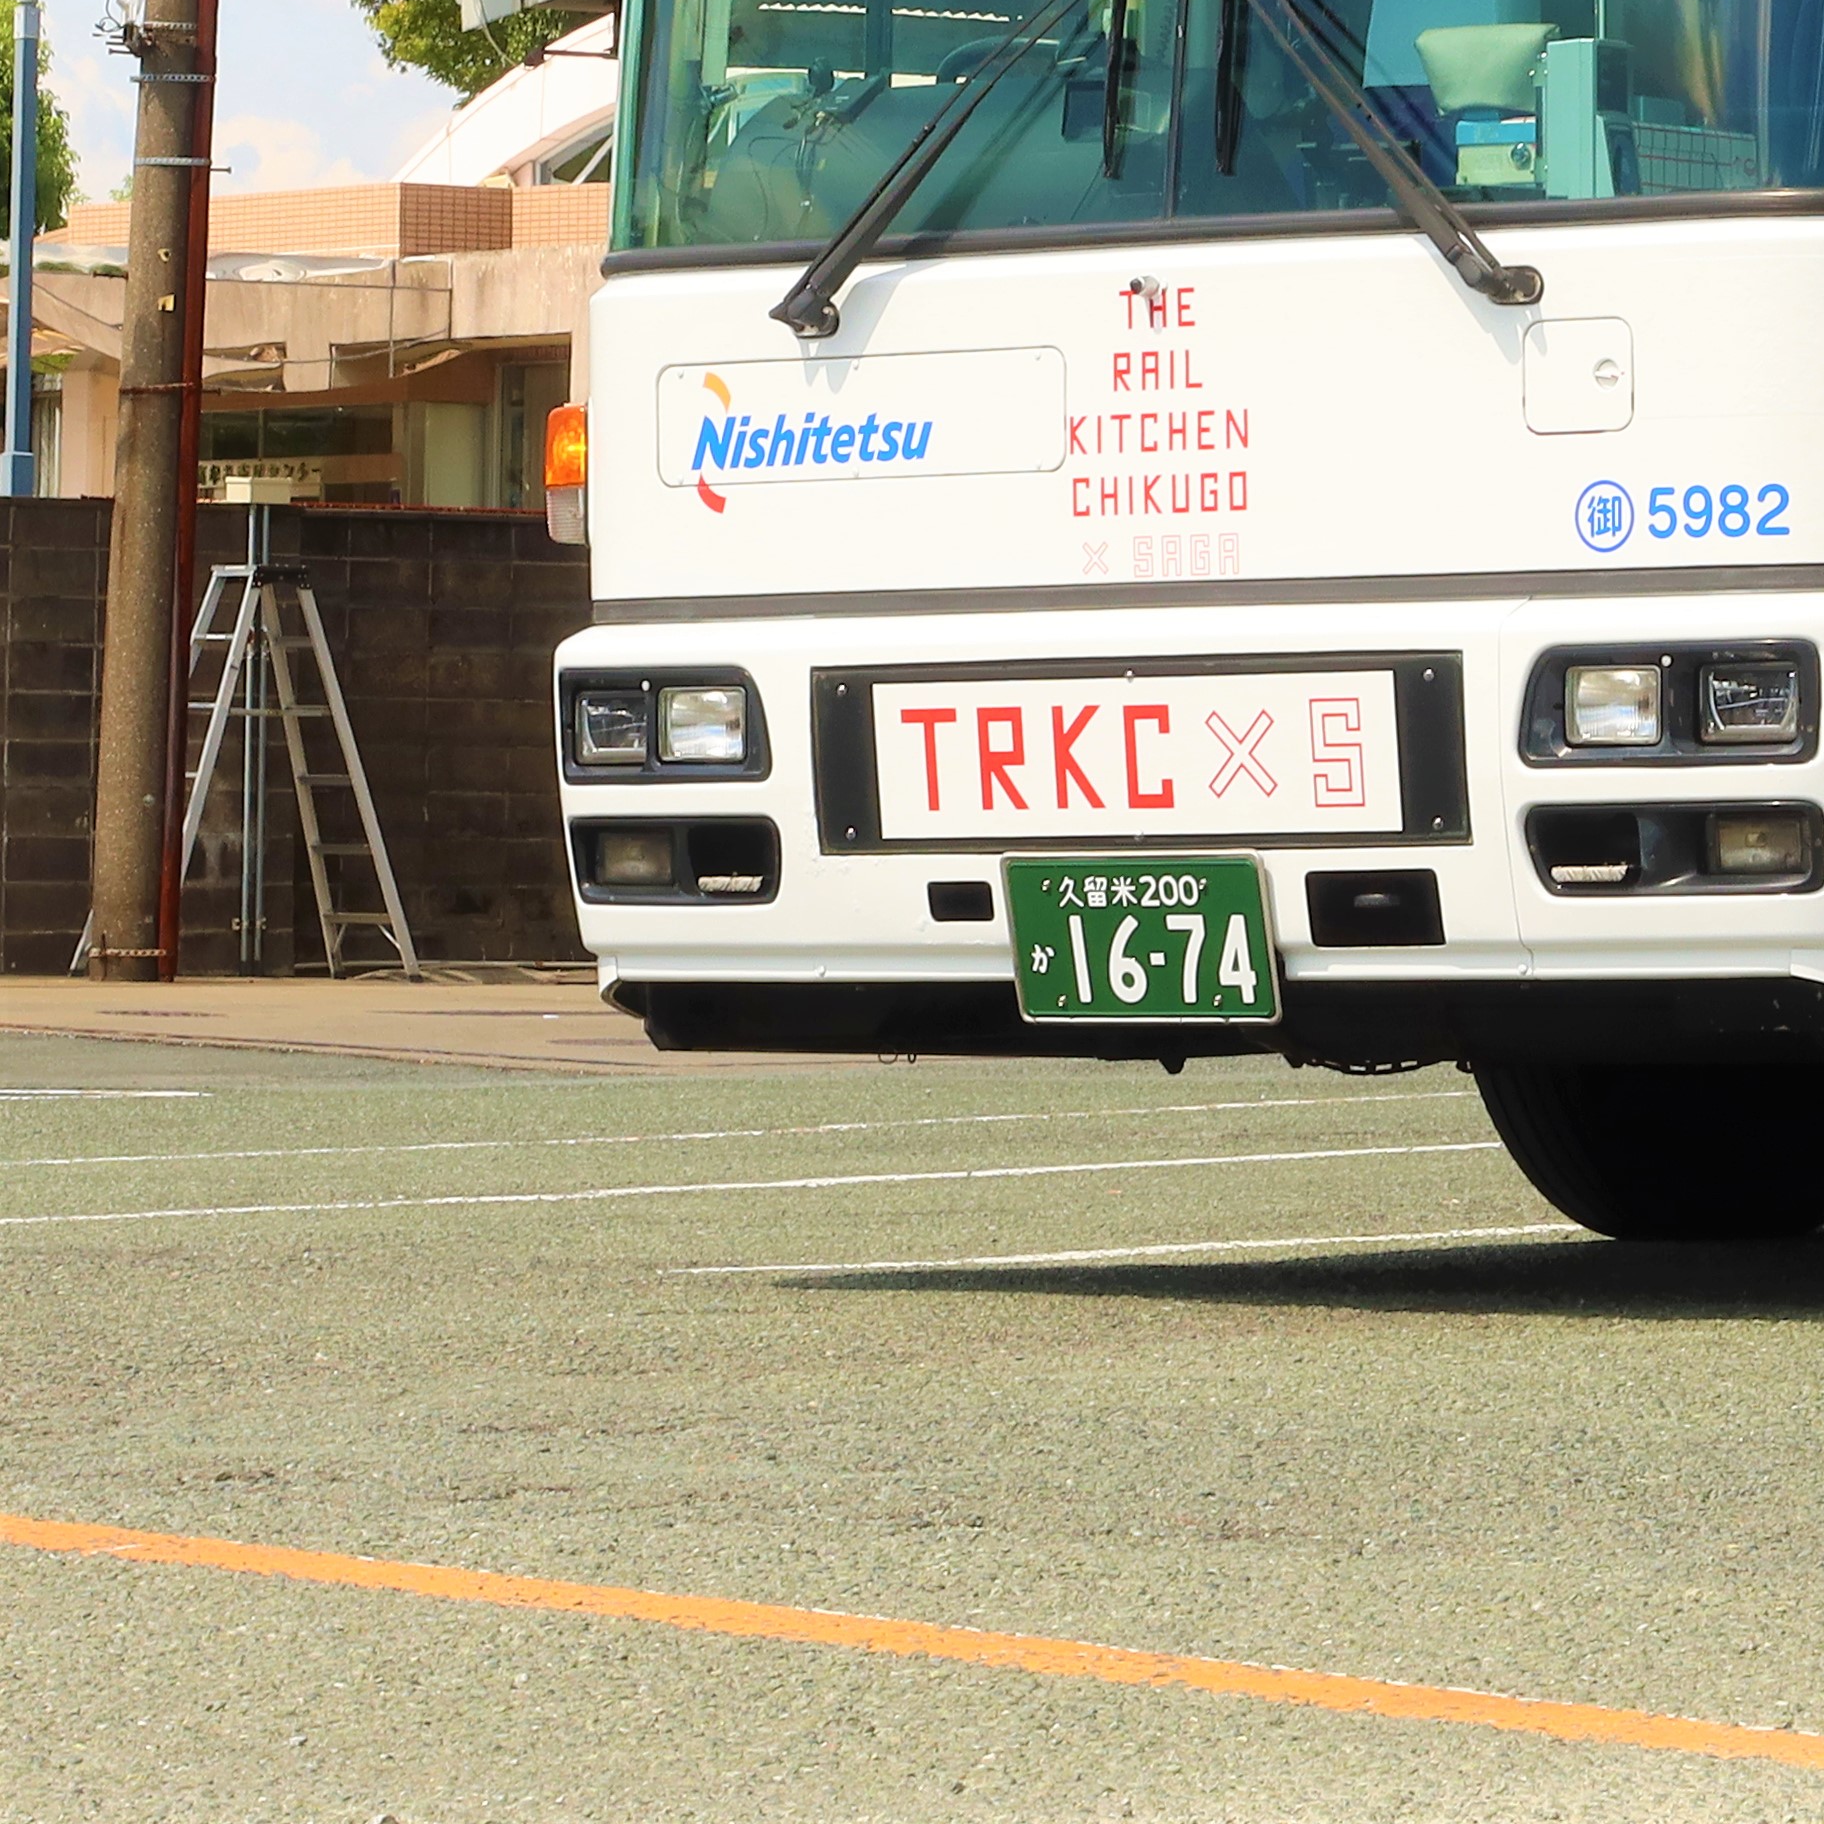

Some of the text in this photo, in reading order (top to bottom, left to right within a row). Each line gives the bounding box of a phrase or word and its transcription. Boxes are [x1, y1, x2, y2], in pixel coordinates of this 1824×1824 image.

[1118, 287, 1197, 331] THE
[1112, 349, 1204, 393] RAIL
[691, 411, 932, 472] Nishitetsu
[1067, 408, 1251, 456] KITCHEN
[1071, 470, 1249, 518] CHIKUGO
[1646, 482, 1791, 539] 5982
[1132, 531, 1242, 579] SAGA
[900, 702, 1175, 813] TRKC
[1029, 913, 1259, 1005] か 16-74
